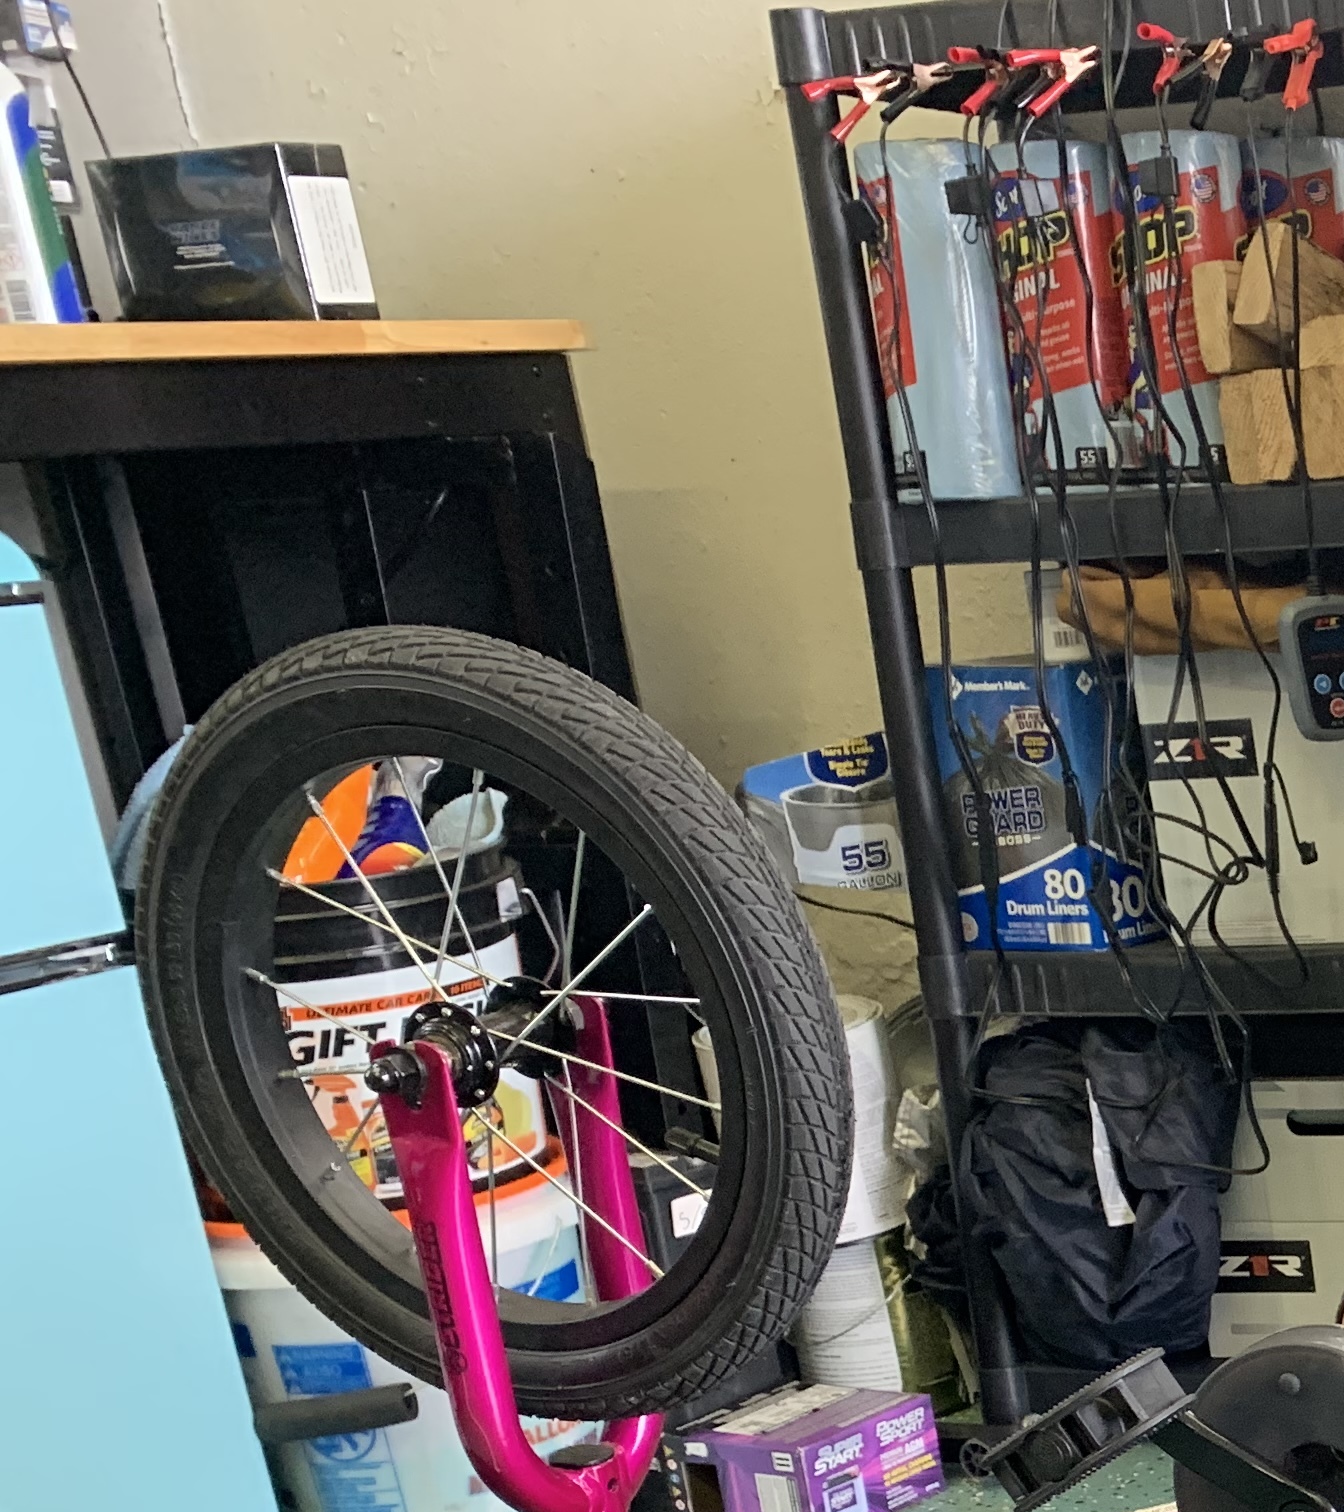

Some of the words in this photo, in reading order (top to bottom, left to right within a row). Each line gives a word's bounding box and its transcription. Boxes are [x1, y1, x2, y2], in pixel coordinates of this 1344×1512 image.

[1079, 449, 1097, 465] 55
[964, 681, 1003, 692] Member's
[1018, 720, 1046, 731] DUTY
[963, 786, 1042, 814] PWER
[841, 840, 889, 873] 55
[1044, 868, 1086, 900] 80
[1006, 900, 1045, 916] Drum
[1047, 899, 1090, 916] Liners
[285, 1021, 387, 1066] GIFT
[1219, 1255, 1303, 1277] Z1R
[876, 1406, 925, 1437] POWER
[879, 1421, 925, 1448] SPORT
[813, 1446, 863, 1477] START
